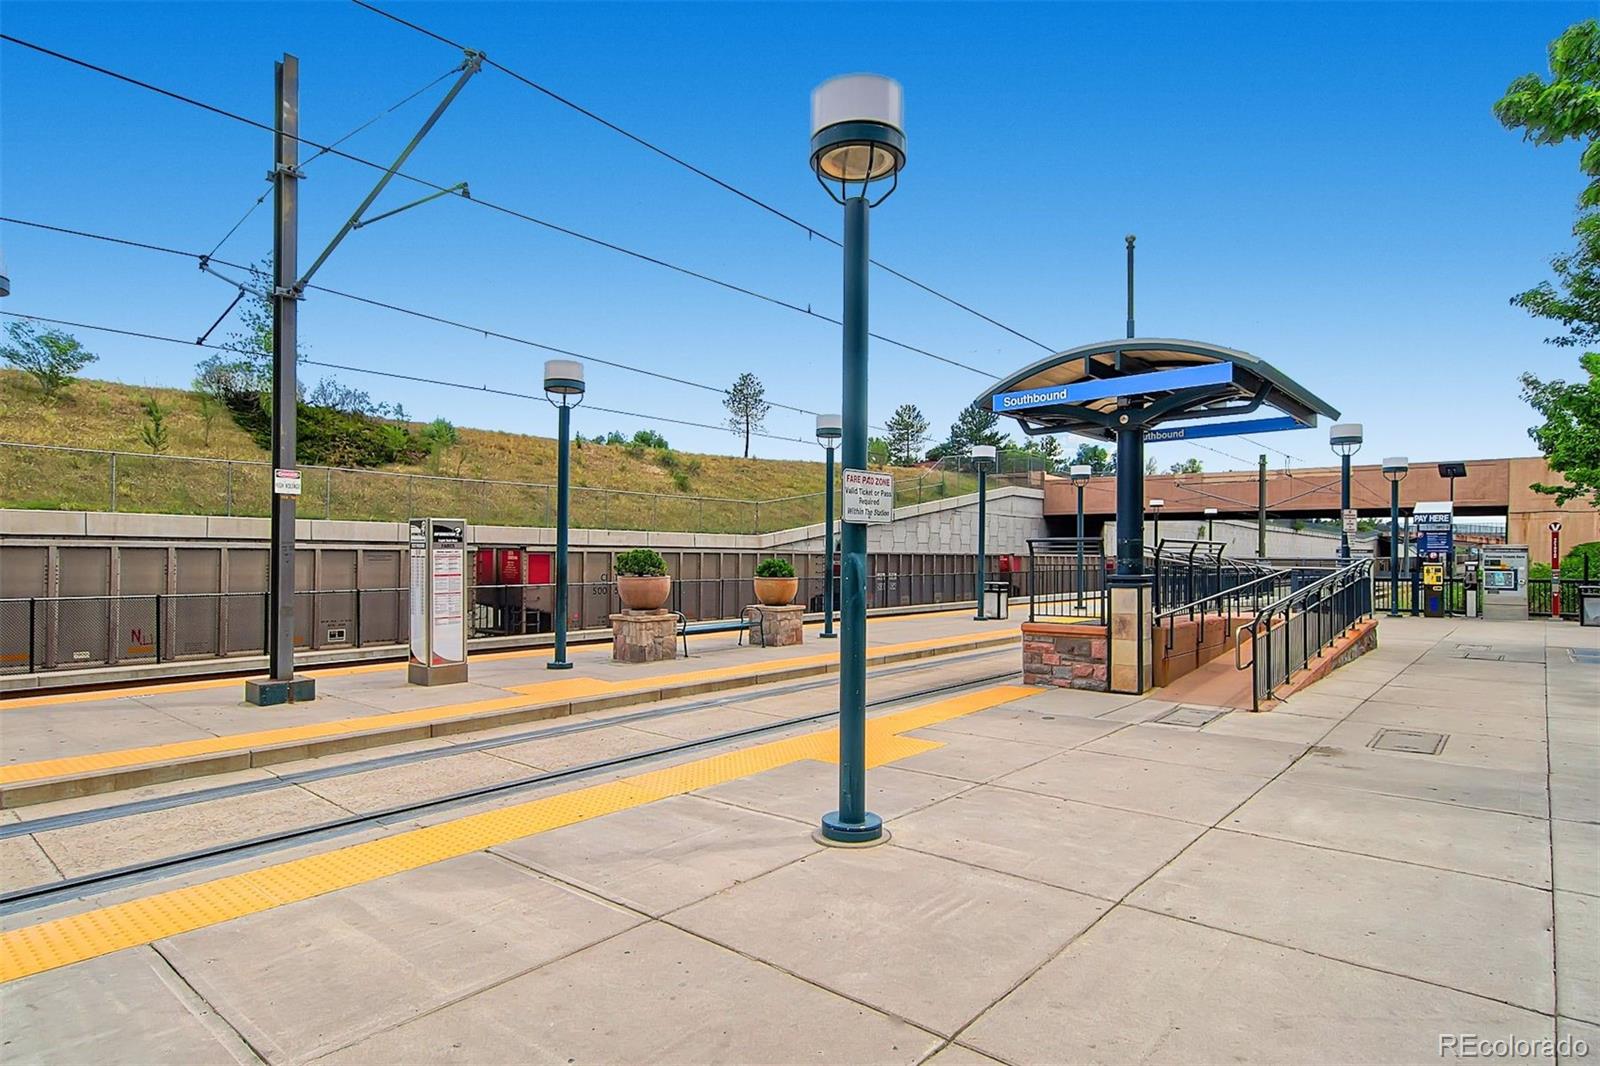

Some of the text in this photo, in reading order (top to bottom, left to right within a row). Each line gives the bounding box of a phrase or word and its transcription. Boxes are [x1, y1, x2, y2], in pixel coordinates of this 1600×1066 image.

[1003, 389, 1067, 407] Southbound
[1144, 429, 1184, 440] uthbound
[846, 474, 861, 484] FARE
[875, 477, 890, 487] ZONE
[844, 487, 859, 495] Valid
[859, 487, 873, 496] Ticket
[880, 489, 892, 498] Pass
[858, 496, 880, 506] Required
[847, 507, 864, 515] Within
[873, 508, 890, 517] Station
[1414, 514, 1450, 523] PAY HERE
